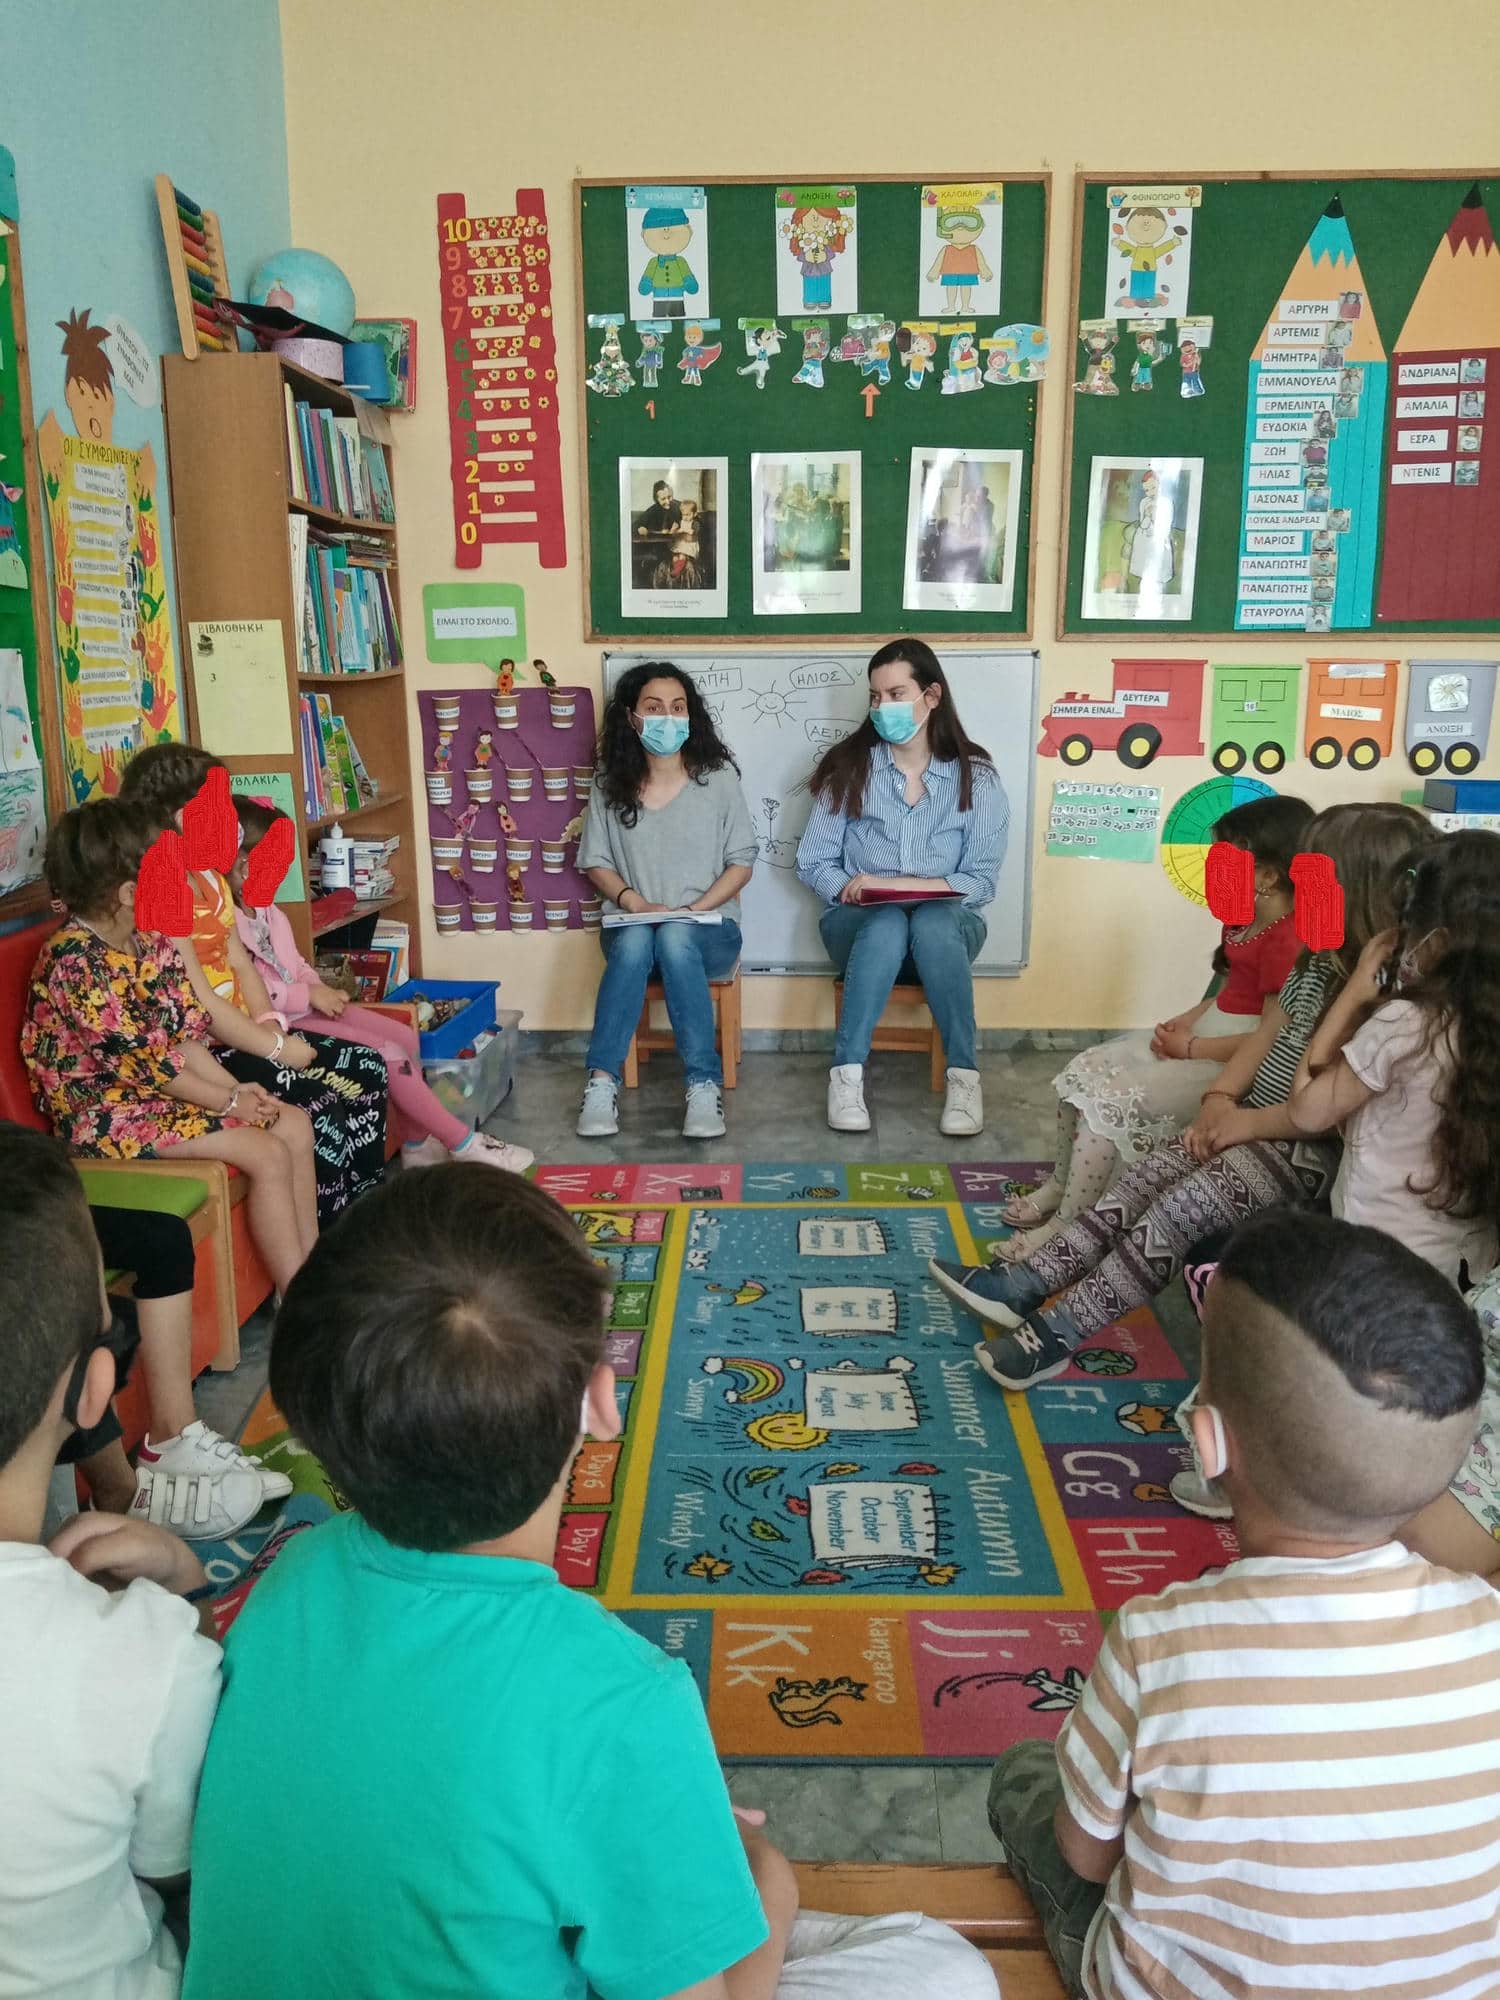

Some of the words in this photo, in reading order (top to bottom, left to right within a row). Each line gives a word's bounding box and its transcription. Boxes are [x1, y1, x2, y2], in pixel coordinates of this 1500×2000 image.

[443, 218, 472, 243] 10
[446, 246, 461, 271] 9
[452, 274, 468, 298] 8
[448, 306, 464, 330] 7
[1288, 305, 1328, 314] ΑΡΓΥΡΗ
[1274, 328, 1320, 337] ΑΡΤΕΜΙΣ
[454, 338, 469, 362] 6
[1264, 353, 1318, 362] ΔΗΜΗΤΡΑ
[462, 368, 476, 392] 5
[1258, 377, 1337, 386] ΕΜΜΑΝΟΥΕΛΑ
[1400, 368, 1456, 378] ΑΝΔΡΙΑΝΑ
[458, 400, 472, 420] 4
[1264, 401, 1326, 410] ΕΡΜΕΛΙΝΤΑ
[1404, 401, 1448, 410] ΑΜΑΛΙΑ
[1262, 423, 1308, 432] ΕΥΔΟΚΙΑ
[64, 438, 73, 456] ΟΙ
[464, 432, 478, 454] 3
[1410, 434, 1436, 444] ΕΣΡΑ
[1264, 447, 1286, 456] ΖΩΗ
[464, 460, 480, 484] 2
[1259, 470, 1290, 478] ΗΛΙΑΣ
[1403, 468, 1440, 477] ΝΤΕΝΙΣ
[468, 492, 482, 515] 1
[1254, 494, 1299, 504] ΙΑΣΟΝΑΣ
[1282, 516, 1320, 524] ΑΝΔΡΕΑΣ
[460, 522, 478, 544] 0
[1254, 536, 1296, 545] ΜΑΡΙΟΣ
[1242, 560, 1308, 569] ΠΑΝΑΓΙΩΤΗΣ
[1243, 584, 1308, 593] ΠΑΝΑΓΙΩΤΗΣ
[460, 618, 474, 626] ΣΤΟ
[1244, 608, 1304, 617] ΣΤΑΥΡΟΥΛΑ
[797, 671, 841, 685] ΗΛΙΟΣ
[1122, 693, 1160, 703] ΔΕΥΤΕΡΑ
[1052, 706, 1090, 714] ΣΗΜΕΡΑ
[810, 726, 850, 740] ΑΕΡΑ
[1426, 725, 1464, 734] ΑΝΟΙΞΗ
[645, 1173, 694, 1195] Xx
[748, 1171, 795, 1191] Yy
[860, 1170, 910, 1191] Zz
[960, 1170, 1009, 1192] Aa
[622, 1292, 645, 1308] Day
[610, 1338, 636, 1354] Day
[675, 1378, 714, 1420] Sunny
[815, 1386, 838, 1418] August
[940, 1360, 988, 1448] Summer
[1036, 1386, 1109, 1416] Ff
[579, 1452, 614, 1476] Day
[583, 1476, 606, 1488] 6
[657, 1490, 705, 1548] Windy
[826, 1489, 852, 1551] November
[860, 1496, 888, 1544] October
[888, 1488, 925, 1553] September
[964, 1466, 1024, 1578] Autumn
[562, 1528, 599, 1554] Day
[567, 1557, 592, 1568] 7
[1088, 1526, 1177, 1586] Hh
[664, 1616, 698, 1650] lion
[920, 1619, 1030, 1660] Jj
[1044, 1618, 1086, 1646] jet
[725, 1622, 812, 1688] Kk
[861, 1616, 901, 1705] kangaroo
